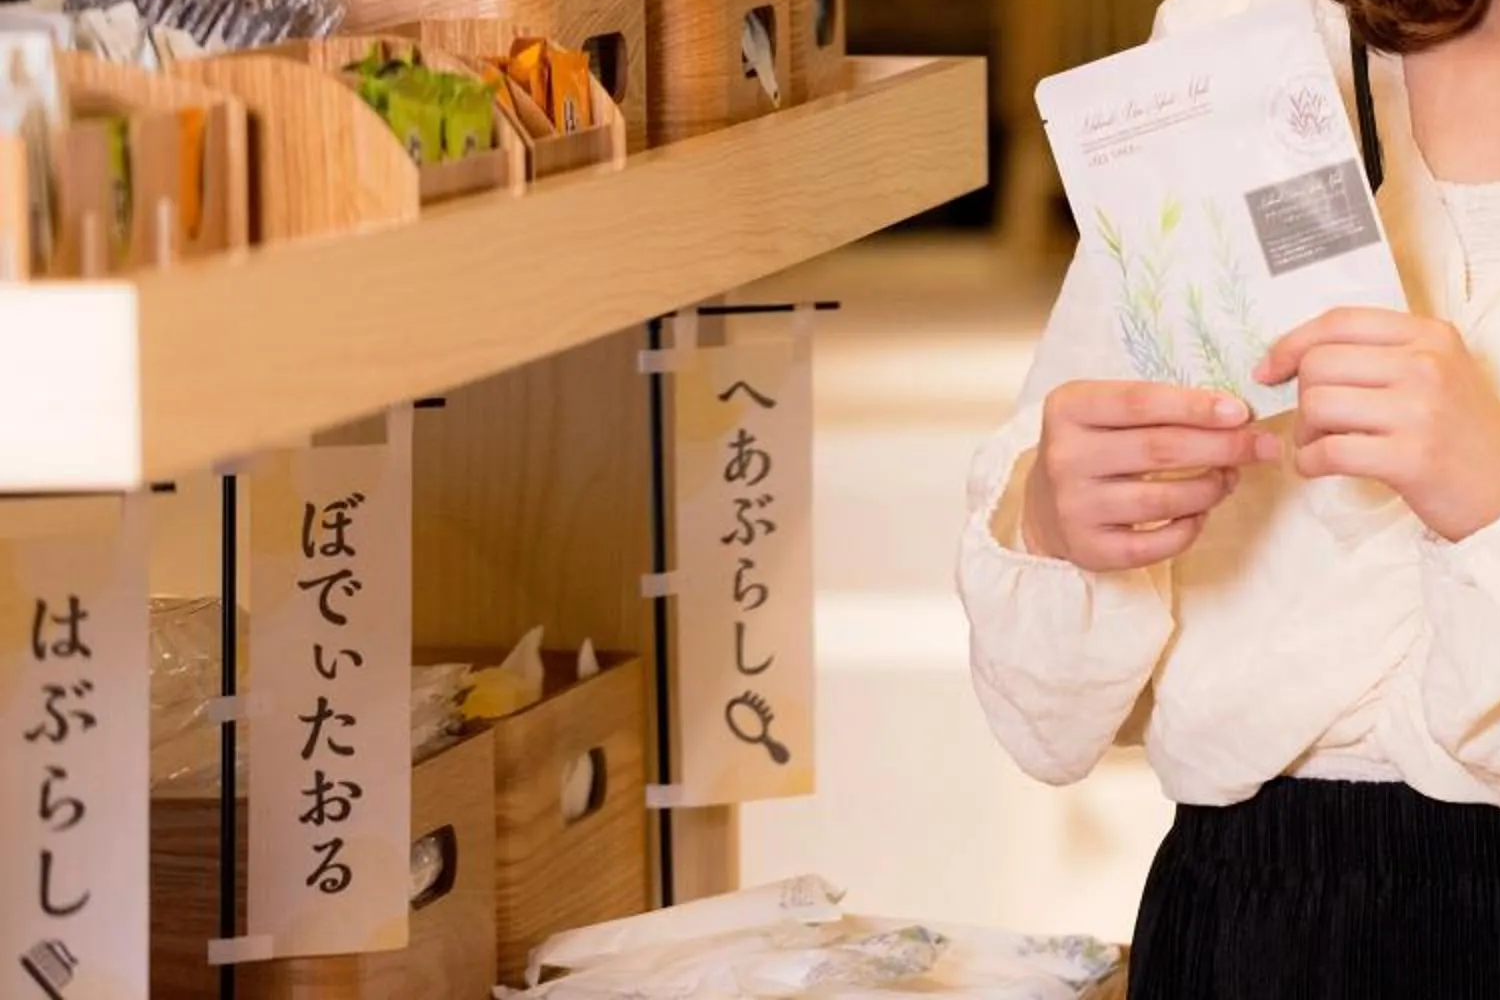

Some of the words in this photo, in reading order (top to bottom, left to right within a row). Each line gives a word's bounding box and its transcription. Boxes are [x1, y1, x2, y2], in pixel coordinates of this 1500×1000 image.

[717, 380, 777, 675] へあぶらし
[24, 595, 97, 918] はぶらし
[297, 492, 366, 895] ぼでぃたおる
